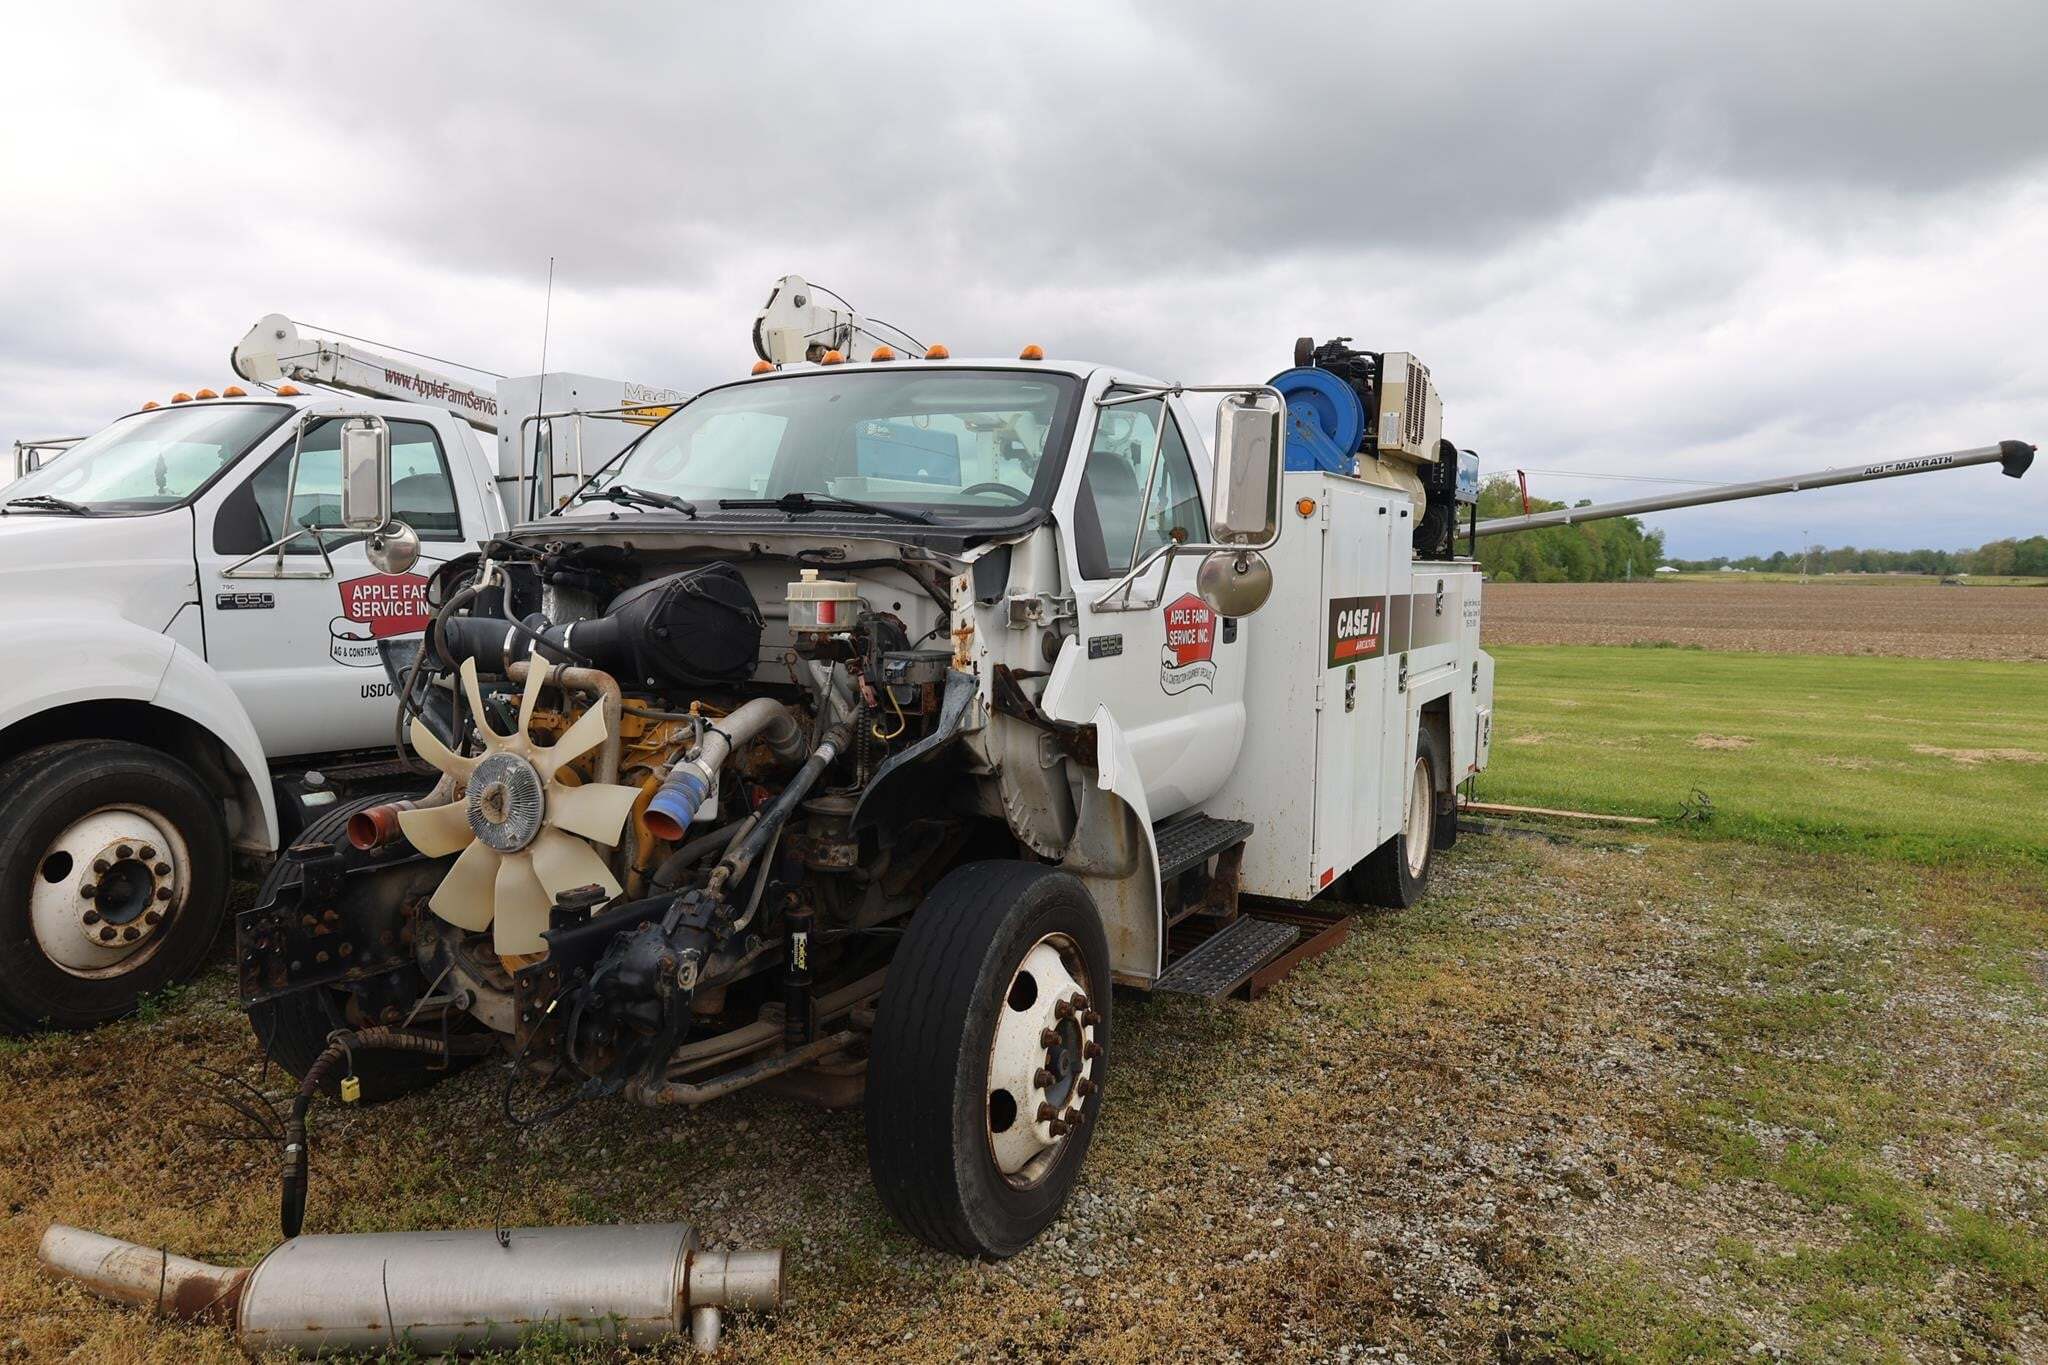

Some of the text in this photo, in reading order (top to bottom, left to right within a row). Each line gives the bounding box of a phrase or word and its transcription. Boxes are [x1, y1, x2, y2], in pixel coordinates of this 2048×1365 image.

[1864, 456, 1953, 475] AGI MAYRATH
[352, 584, 399, 600] APPLE
[352, 600, 429, 617] SERVICE IN
[1170, 608, 1209, 625] APPLE FARM
[1337, 608, 1369, 639] CASE
[1169, 628, 1196, 646] SERVICE
[333, 646, 379, 658] AG & CONSTRUC
[361, 683, 394, 699] USDO
